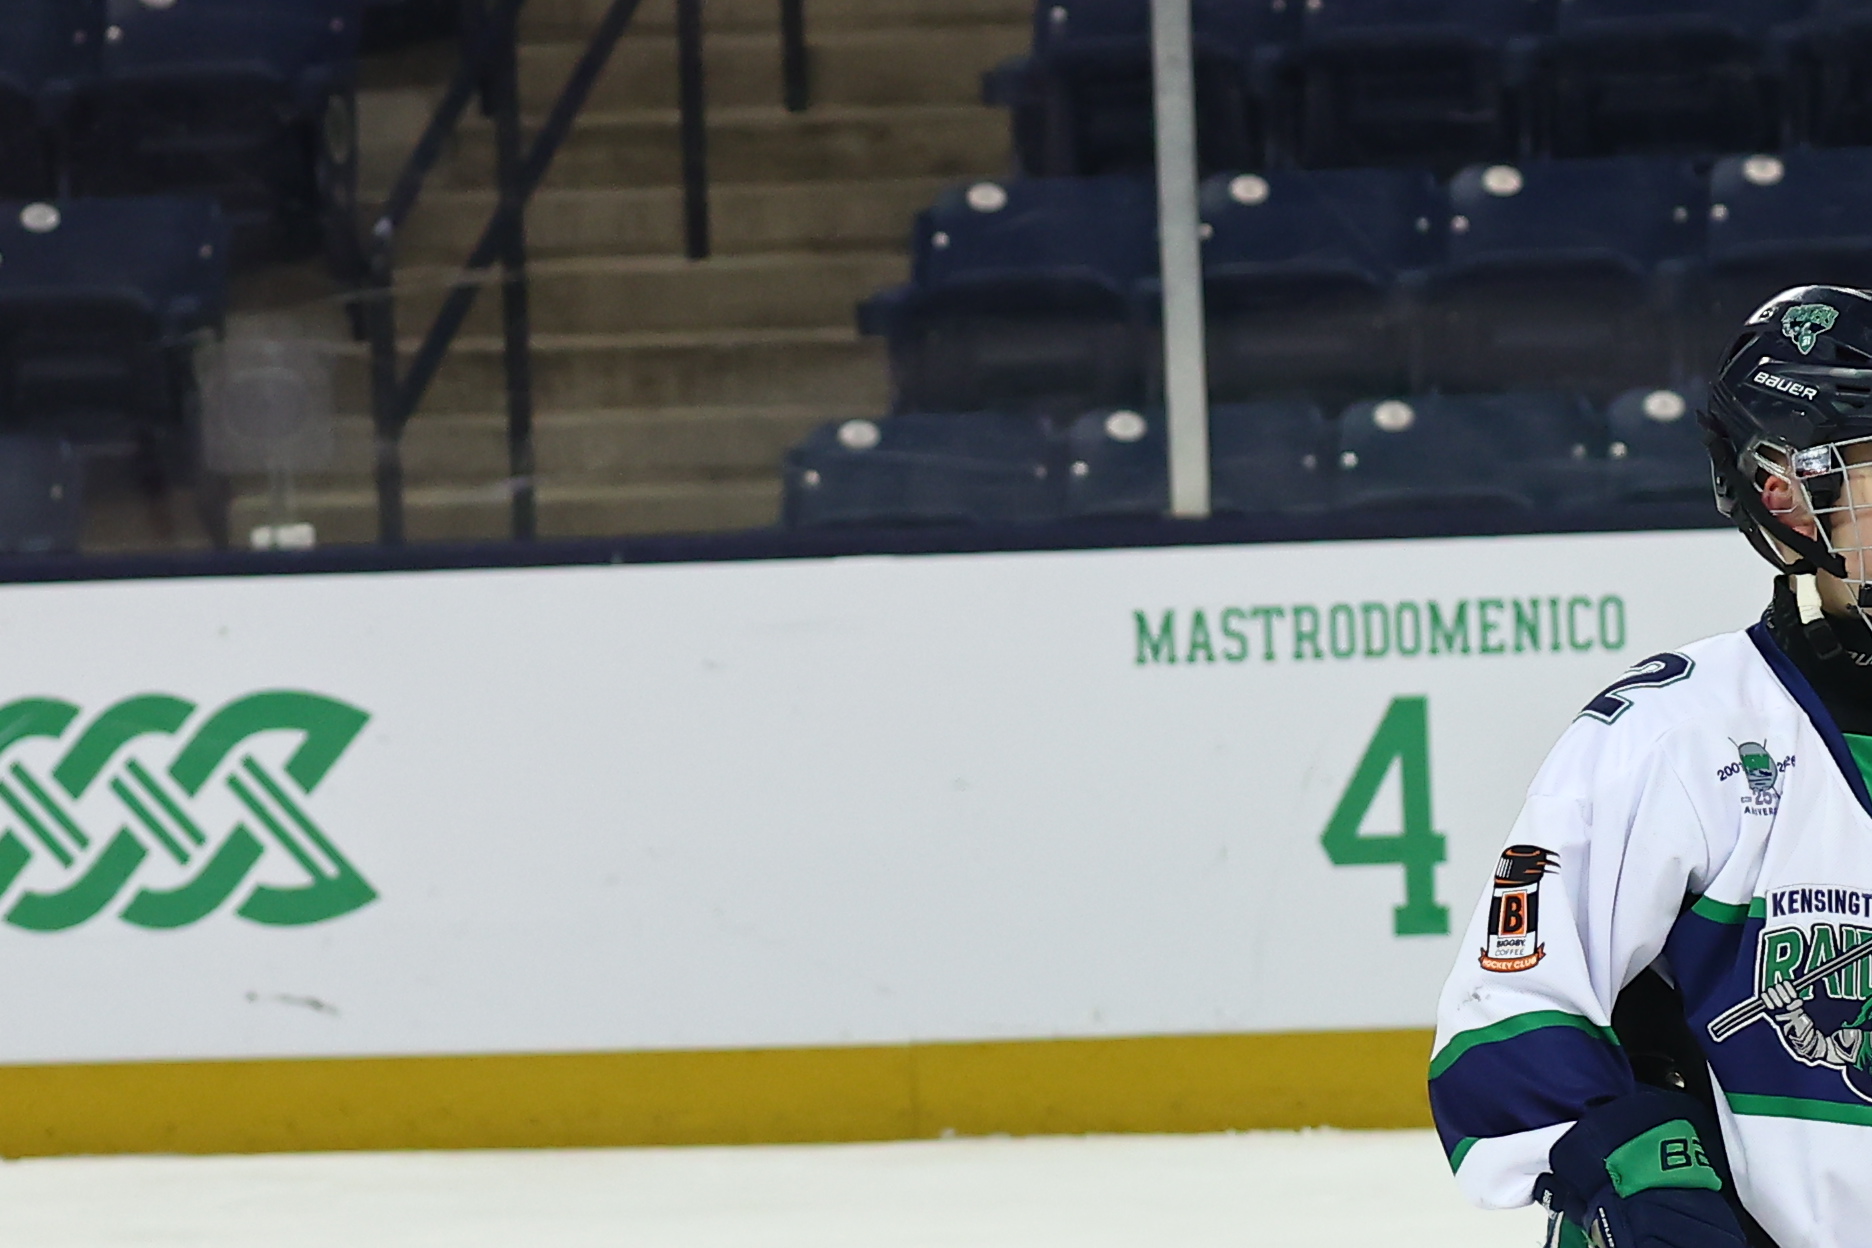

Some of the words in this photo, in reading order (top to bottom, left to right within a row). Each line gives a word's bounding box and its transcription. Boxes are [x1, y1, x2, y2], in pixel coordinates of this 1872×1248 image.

[1753, 371, 1818, 401] BAUER
[1133, 595, 1627, 666] MASTRODOMENICO
[1320, 694, 1450, 936] 4
[1503, 896, 1523, 933] B
